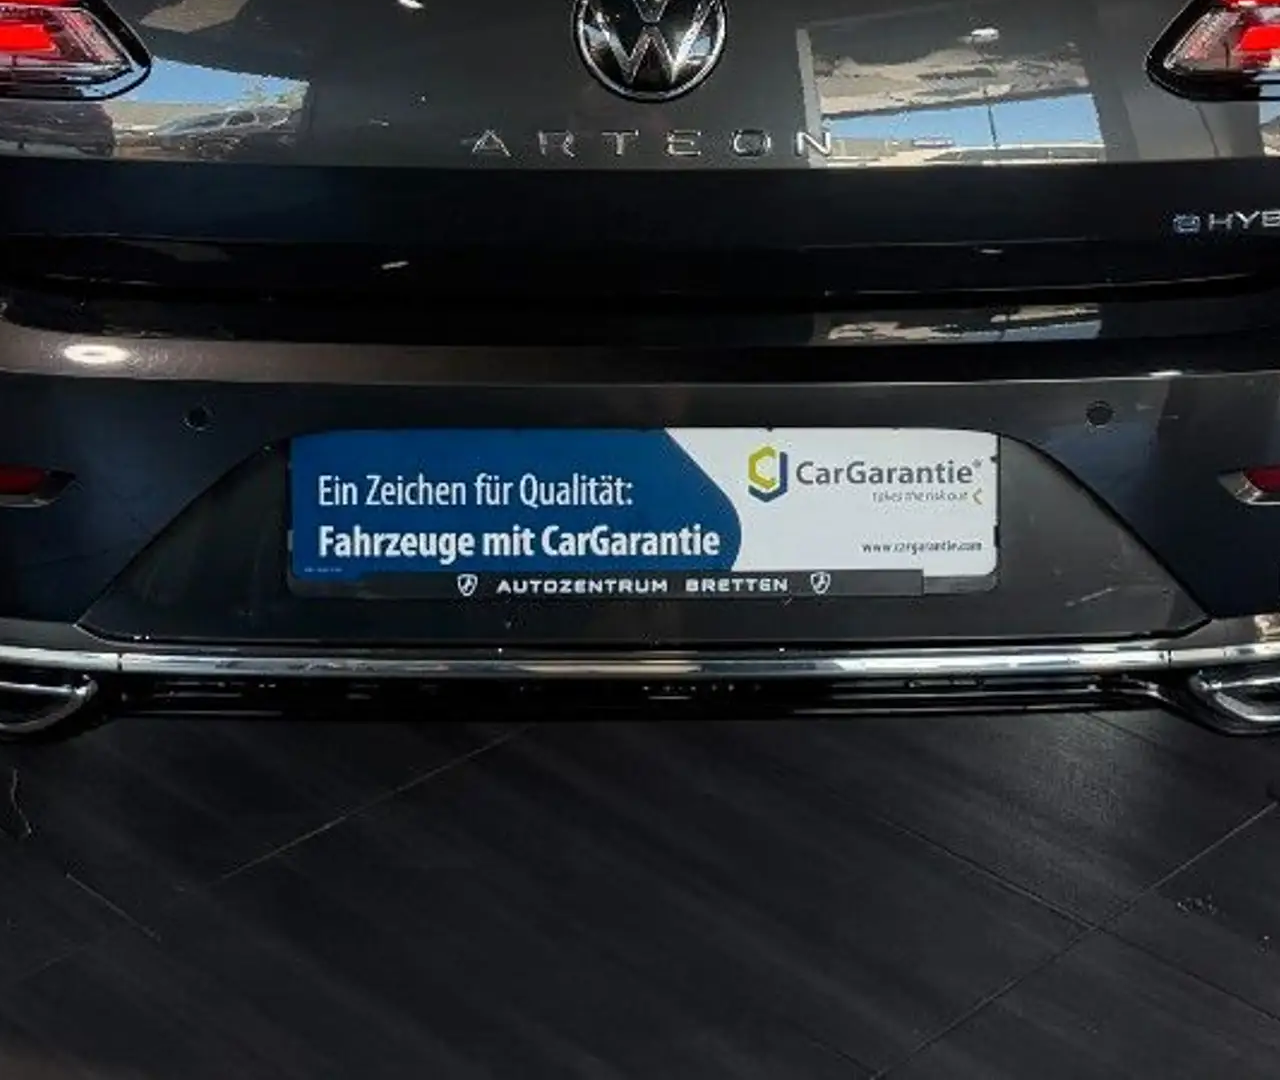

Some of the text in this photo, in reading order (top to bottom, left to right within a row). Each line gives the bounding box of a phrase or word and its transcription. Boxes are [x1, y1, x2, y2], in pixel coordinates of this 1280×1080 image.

[472, 128, 832, 158] ARTEON
[318, 472, 634, 509] Ein Zeichen für Qualität:
[318, 523, 721, 566] Fahrzeuge mit CarGarantie
[495, 577, 789, 594] AUTOZENTRUM BRETTEN
